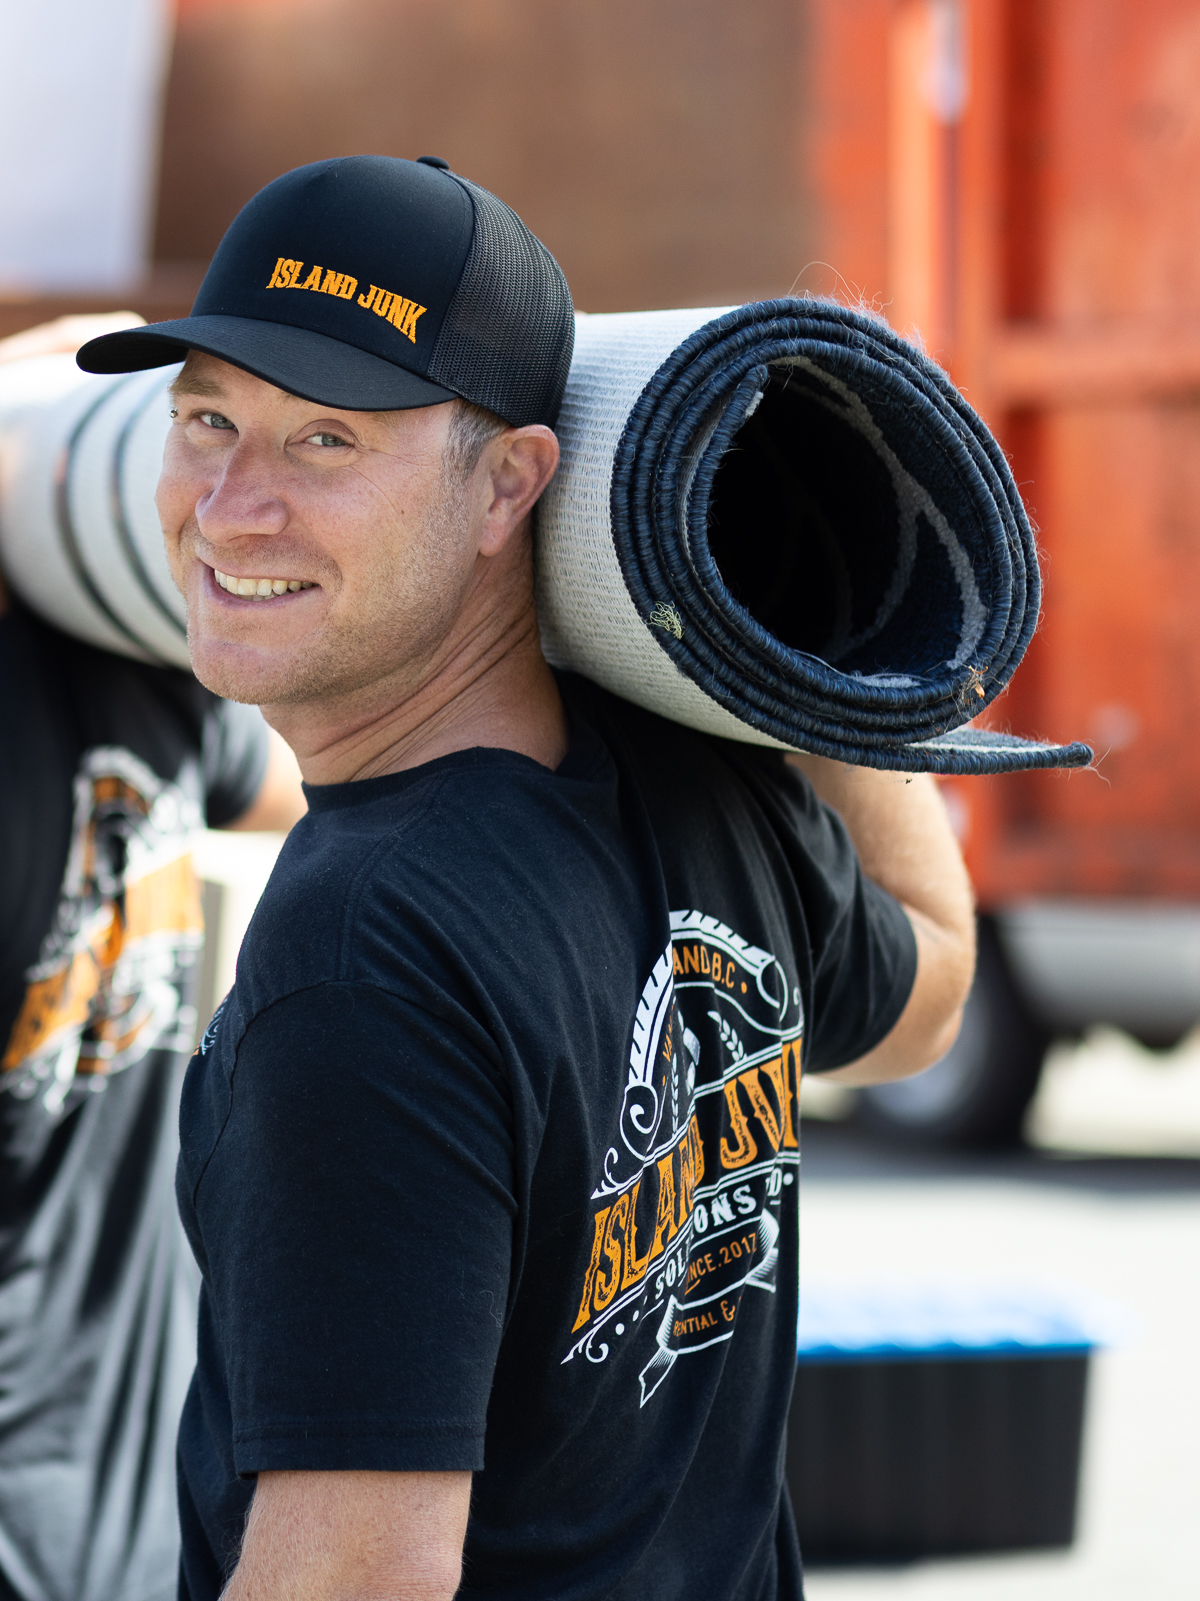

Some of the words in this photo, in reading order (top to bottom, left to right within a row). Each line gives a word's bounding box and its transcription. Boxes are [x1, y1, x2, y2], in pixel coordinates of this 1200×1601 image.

[266, 257, 358, 300] ISLAND
[357, 284, 427, 344] JUNK
[571, 1113, 705, 1335] ISLAND
